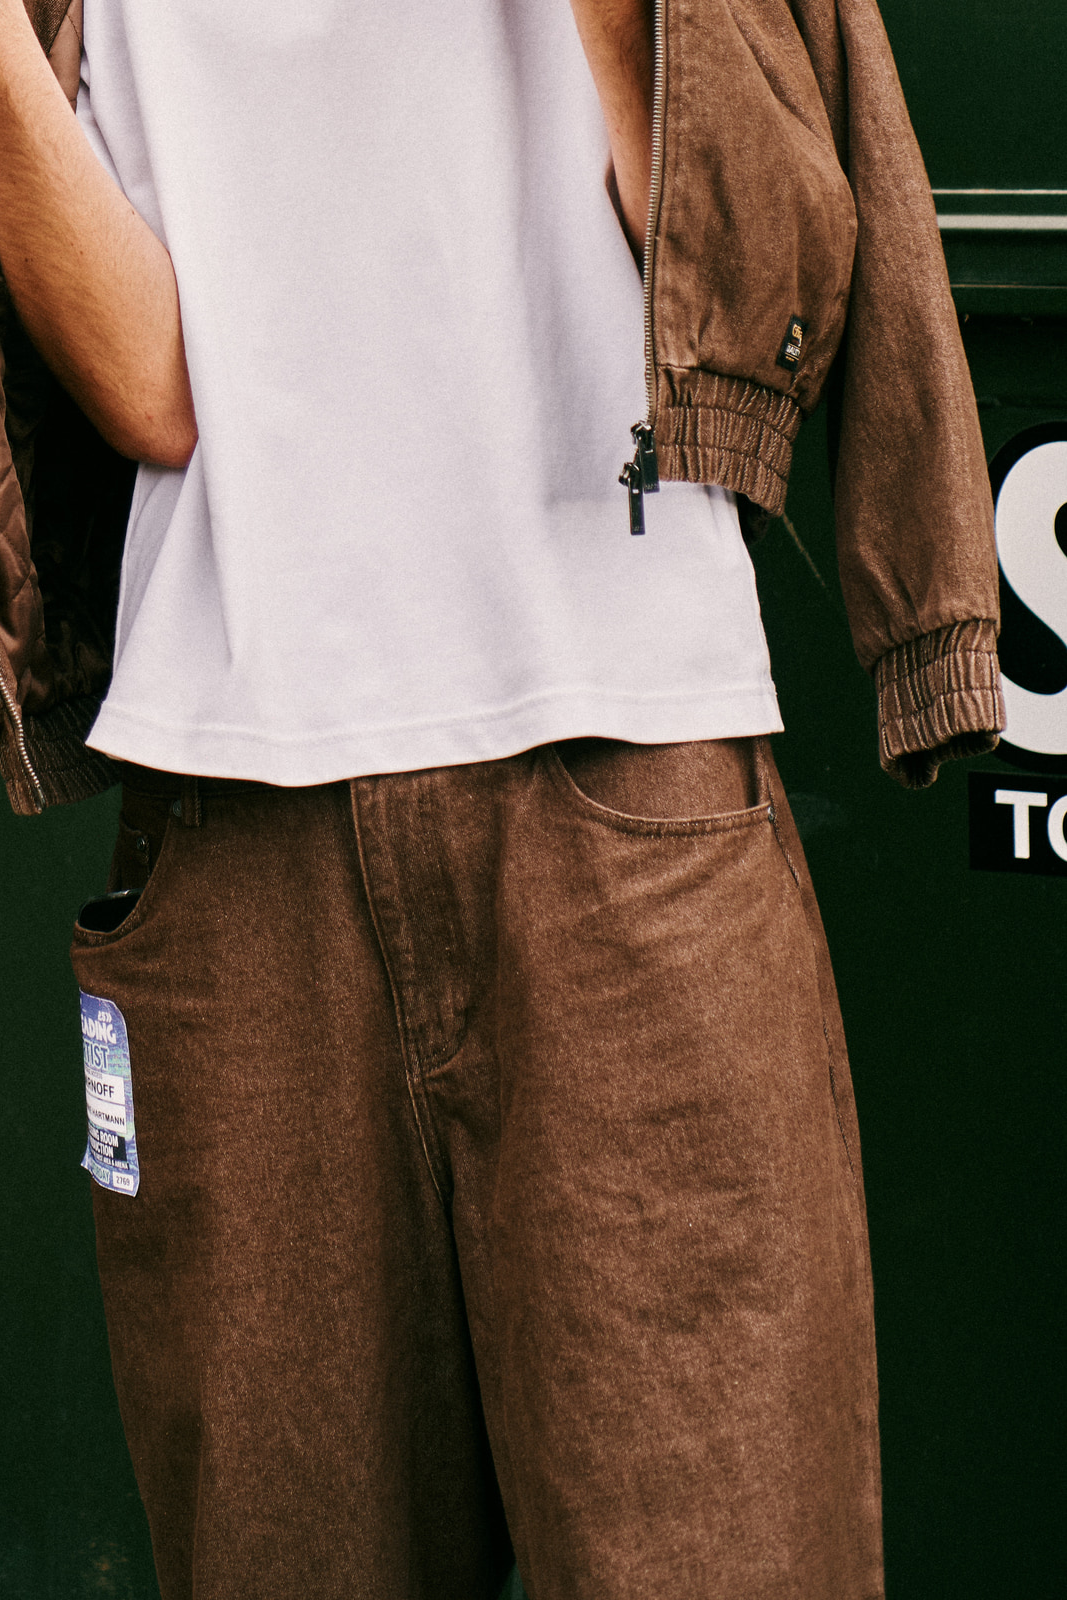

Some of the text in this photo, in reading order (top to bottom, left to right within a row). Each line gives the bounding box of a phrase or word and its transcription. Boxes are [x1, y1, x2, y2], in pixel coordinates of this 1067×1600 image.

[81, 1013, 117, 1045] ADING
[84, 1040, 109, 1071] TIST
[99, 1130, 119, 1148] ROOM
[116, 1175, 131, 1187] 2769
